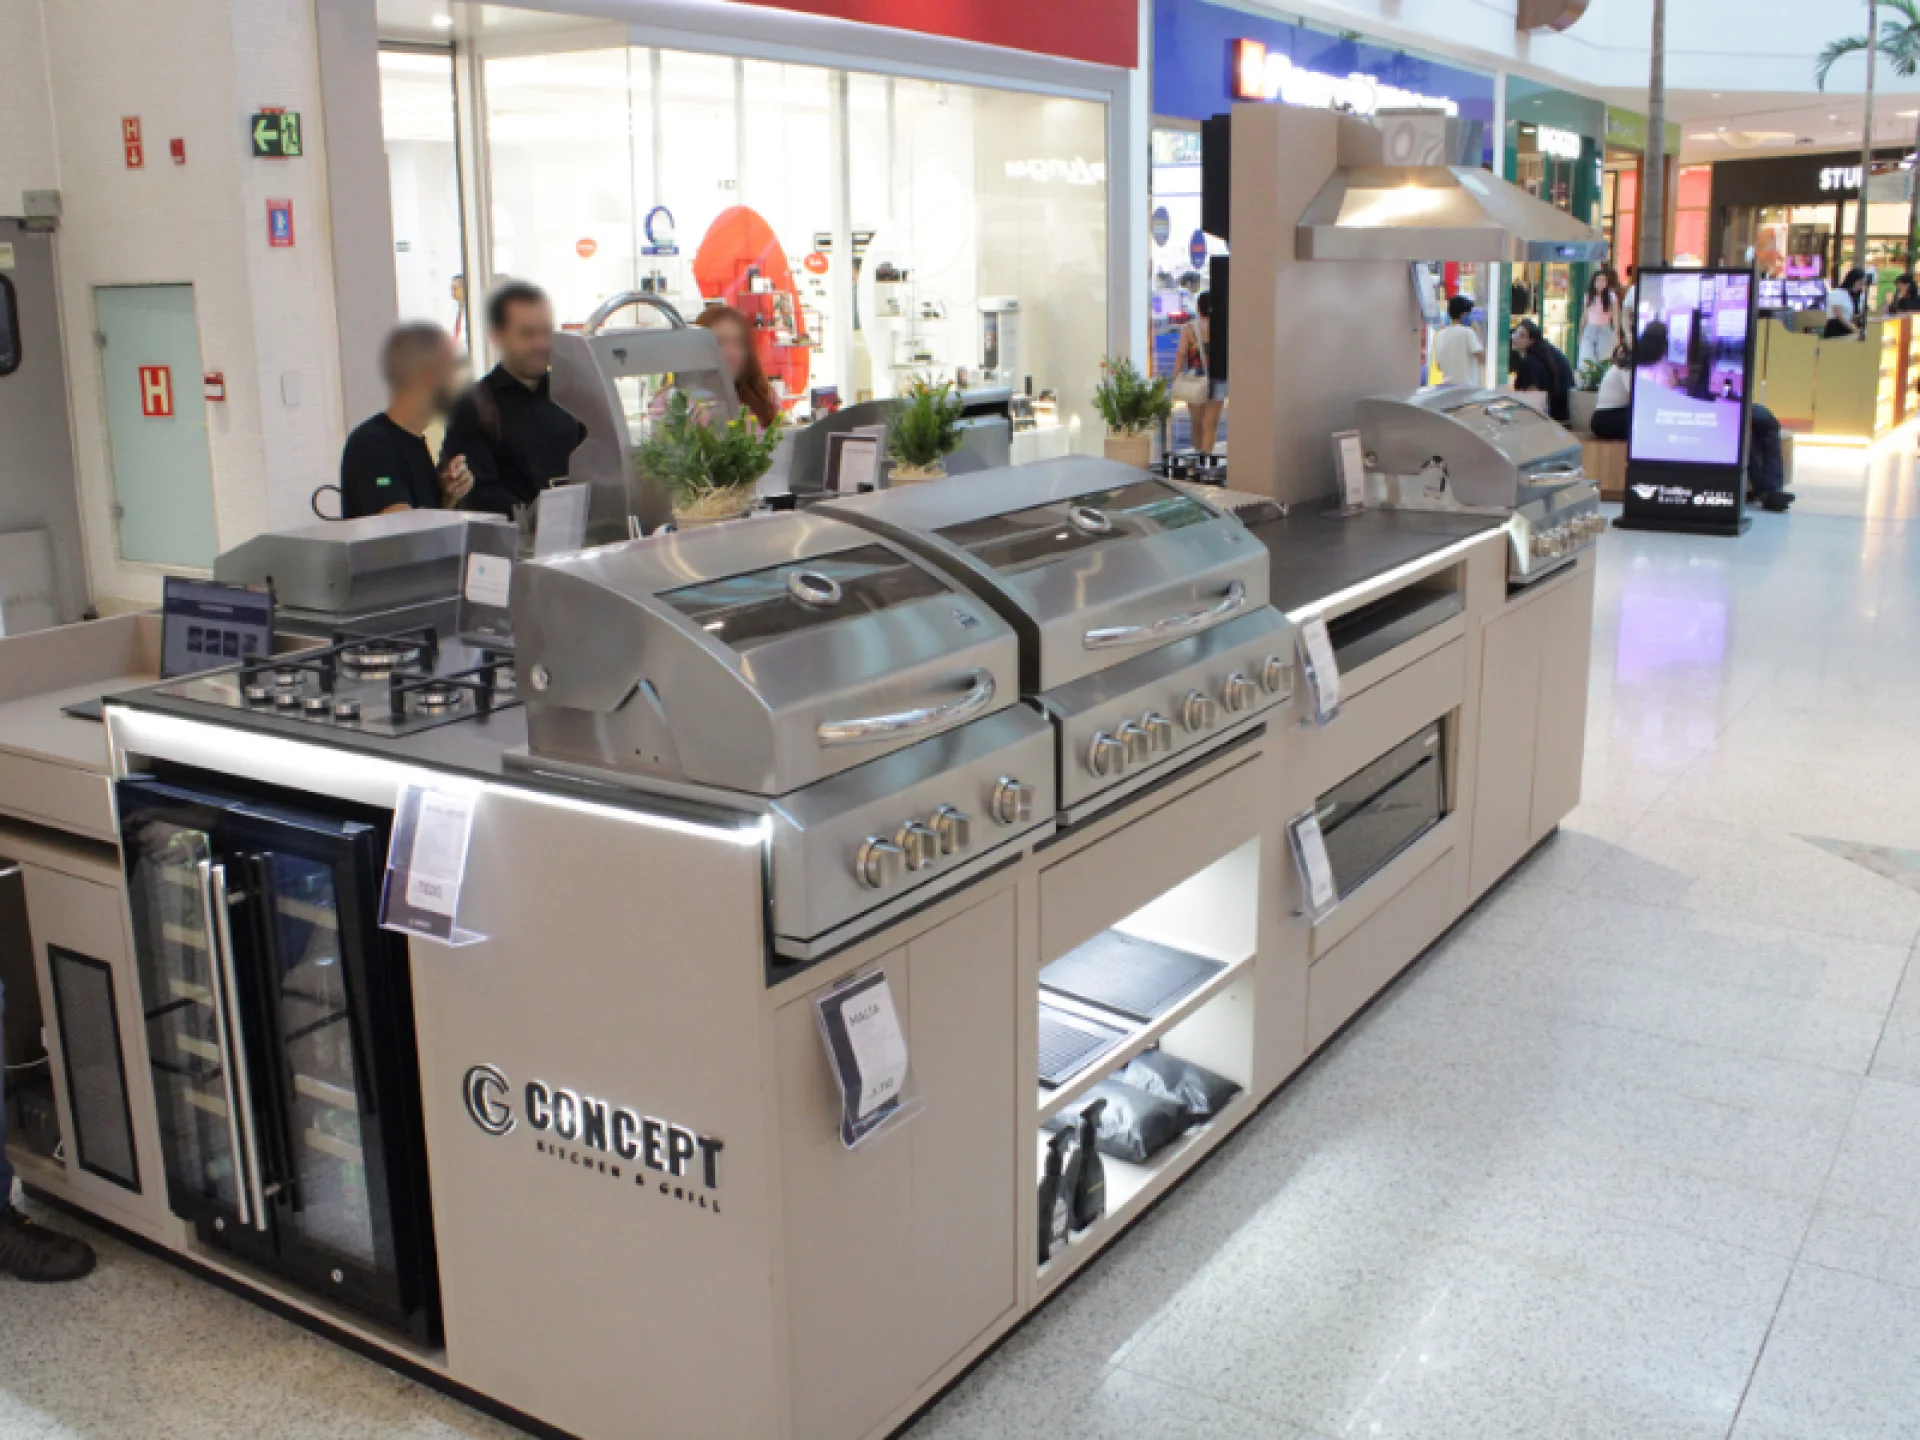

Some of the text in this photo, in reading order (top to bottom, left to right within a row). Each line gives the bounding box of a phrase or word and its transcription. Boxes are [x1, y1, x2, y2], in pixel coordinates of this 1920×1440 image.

[143, 369, 169, 413] H
[524, 1078, 724, 1189] CONCEPT
[536, 1139, 620, 1178] KITCHEN
[659, 1181, 721, 1213] GRILL
